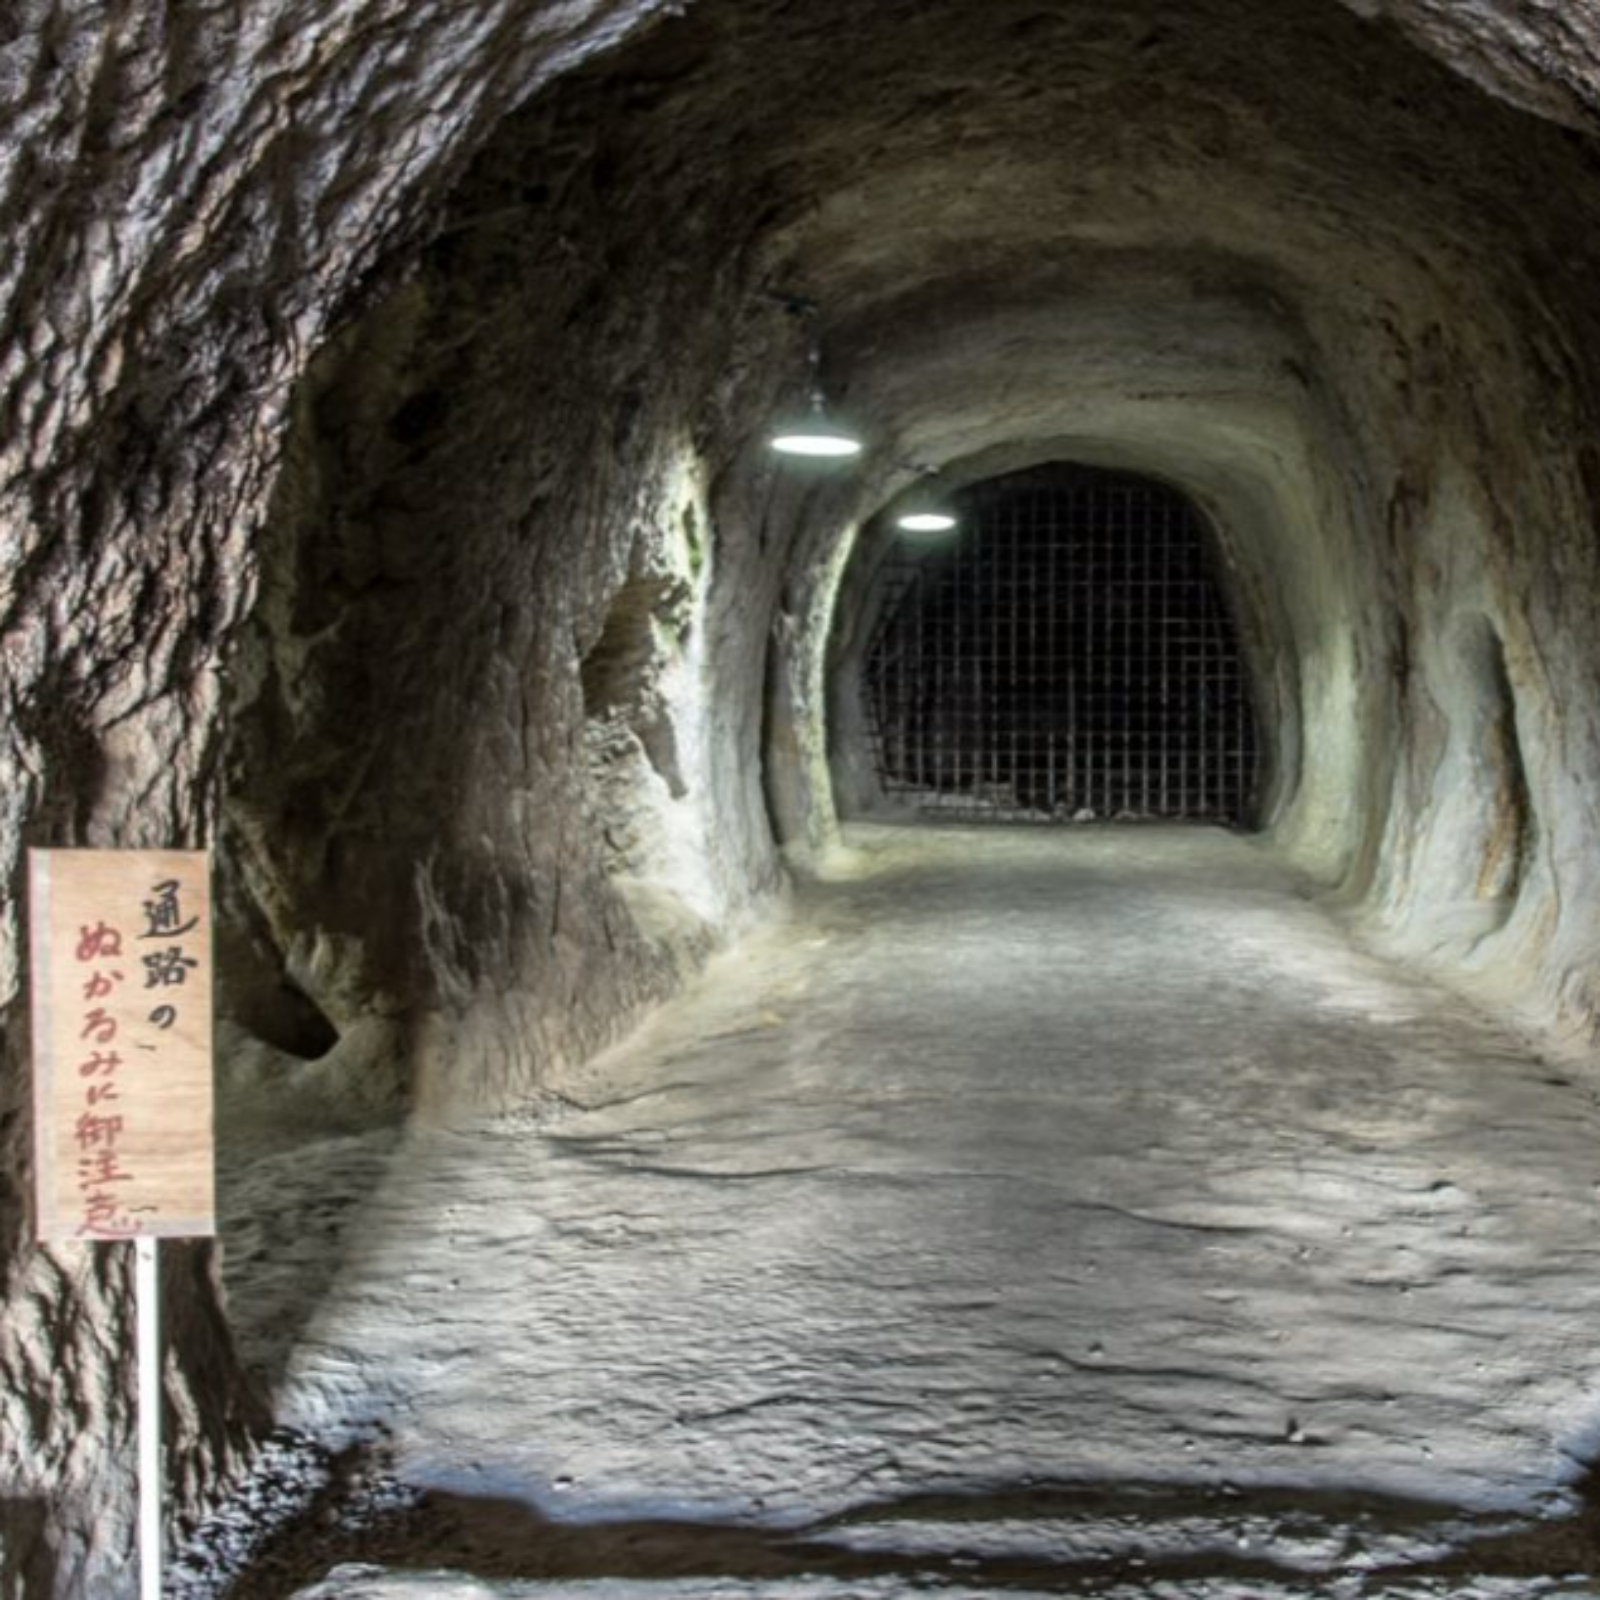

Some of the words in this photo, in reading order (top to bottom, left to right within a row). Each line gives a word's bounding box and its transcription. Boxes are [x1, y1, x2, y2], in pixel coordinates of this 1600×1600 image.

[138, 879, 199, 1029] 通路の
[75, 921, 142, 1237] ぬかるみに御注意
